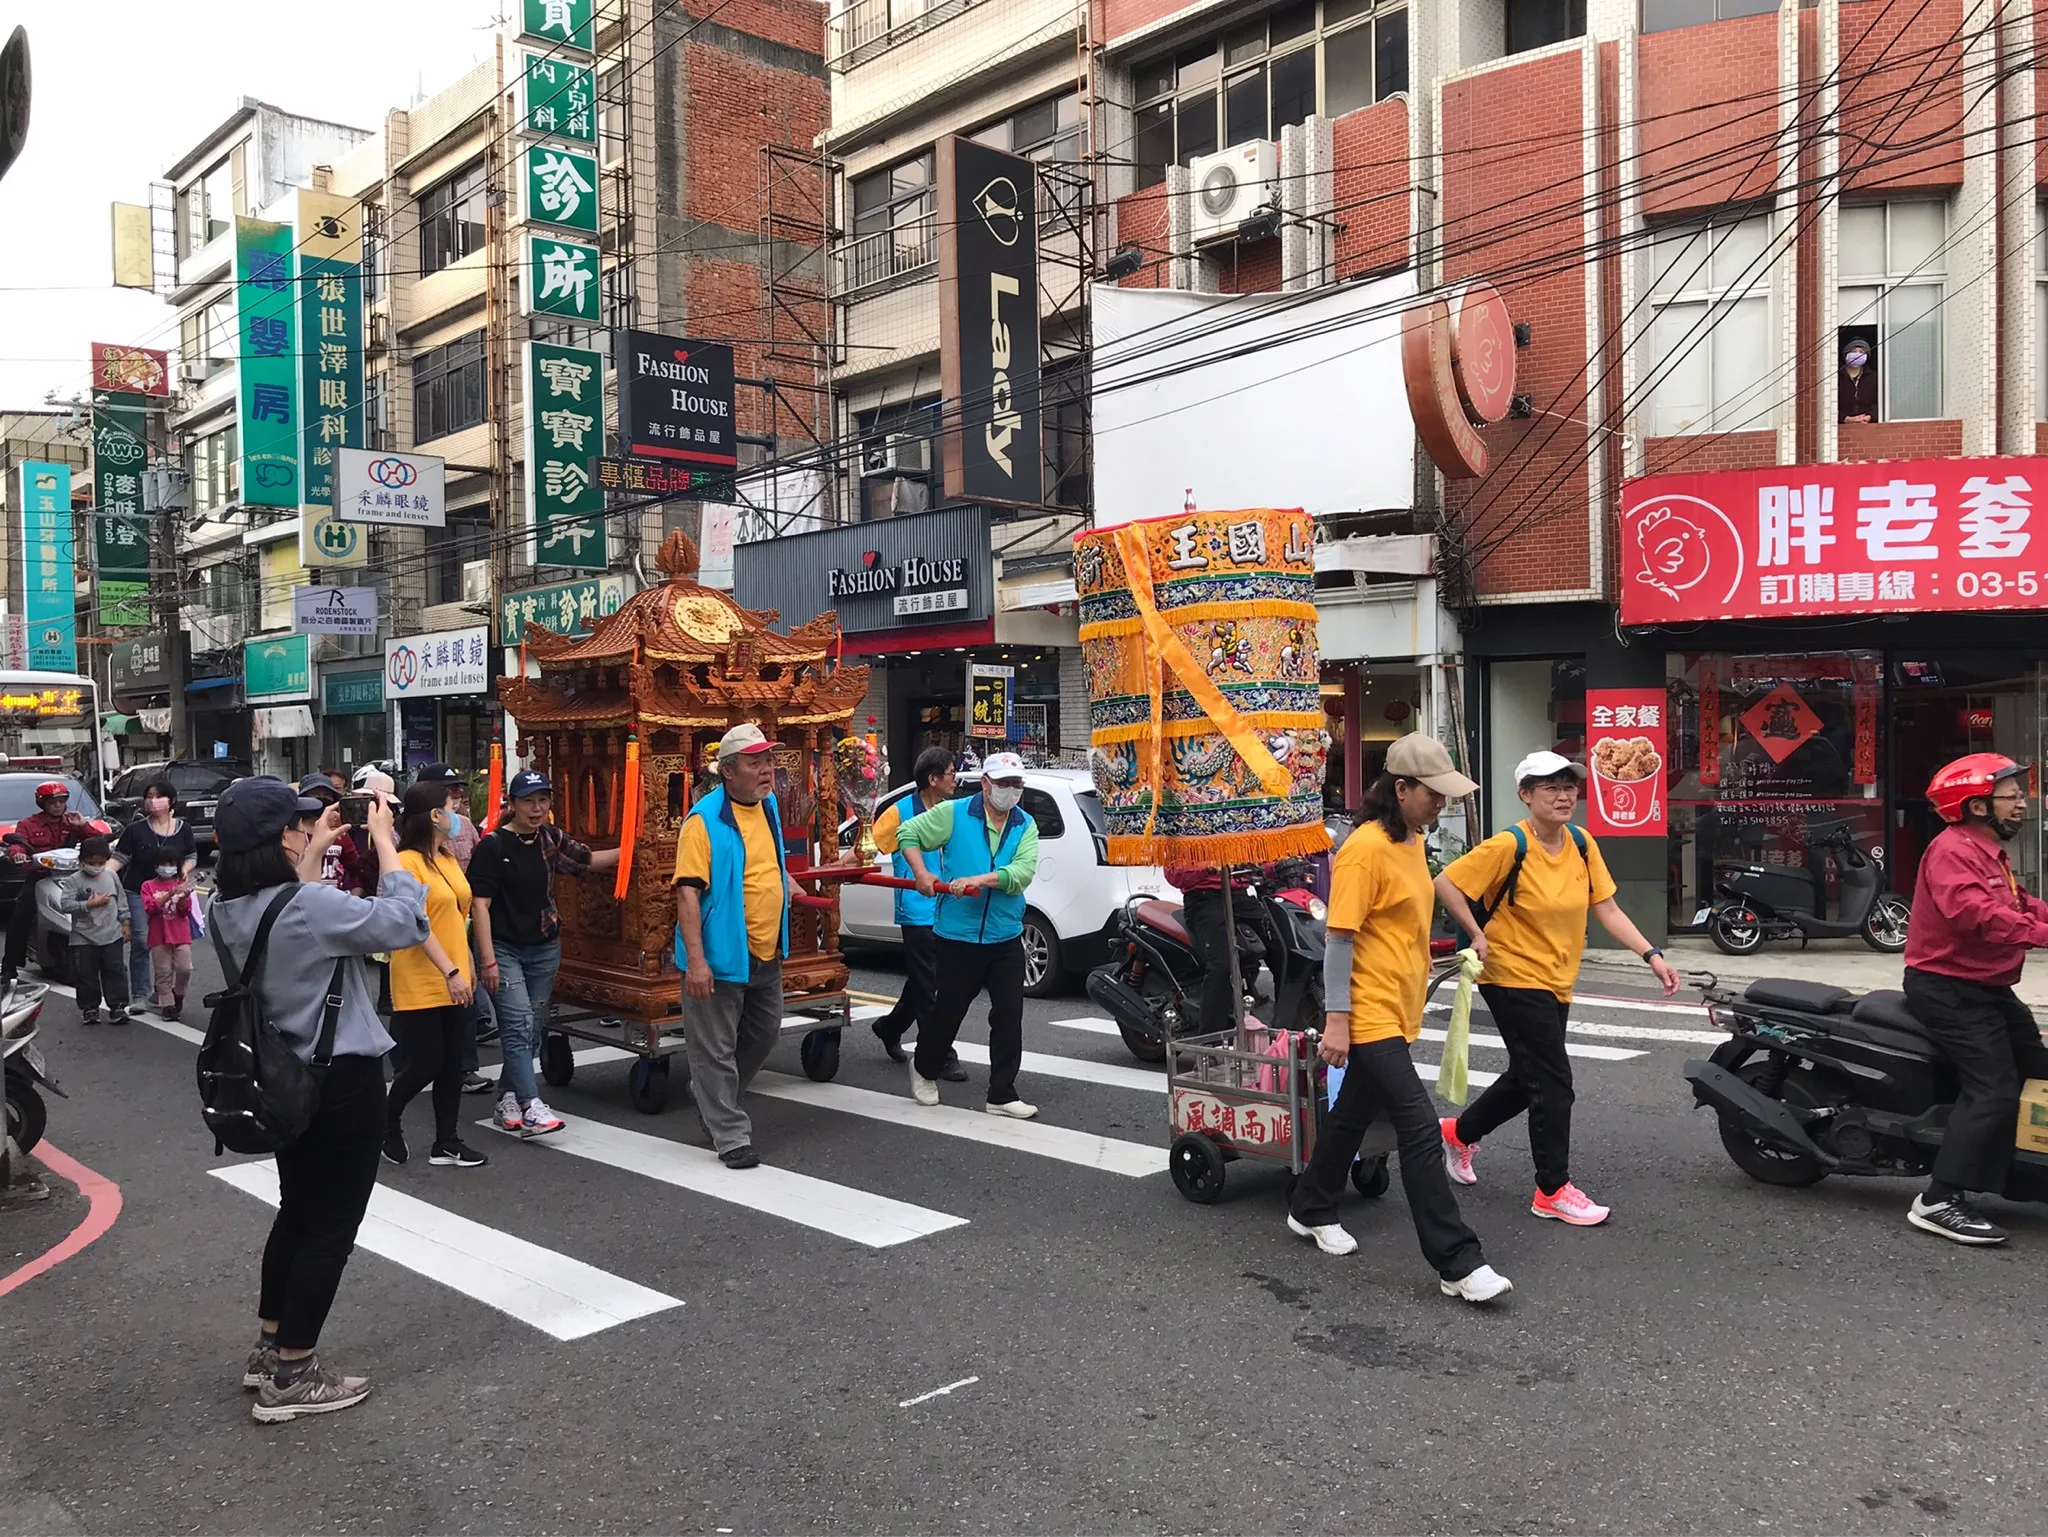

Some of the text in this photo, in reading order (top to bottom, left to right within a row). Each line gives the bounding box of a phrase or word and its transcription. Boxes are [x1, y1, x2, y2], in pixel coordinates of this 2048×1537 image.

[532, 59, 558, 131] 內科
[565, 66, 591, 138] 小兒科
[532, 151, 594, 314] 診所
[316, 270, 350, 445] 張世澤眼科
[637, 351, 710, 385] FASHION
[985, 271, 1023, 480] Lady
[670, 388, 729, 418] HOUSE
[648, 421, 722, 445] 流行飾品屋
[539, 357, 596, 557] 寶寶診所
[115, 473, 138, 546] 麥味登
[357, 489, 430, 512] 采麟眼鏡
[357, 507, 429, 521] frame and lenses
[104, 506, 116, 545] Bunch
[1757, 475, 2034, 567] 胖老爹
[827, 556, 963, 598] FASHION HOUSE
[1956, 571, 2048, 603] 03-5
[315, 606, 358, 616] RODENSTOCK
[897, 593, 958, 613] 流行飾品屋
[419, 634, 485, 673] 采麟眼鏡
[419, 671, 485, 689] frame and lenses
[973, 684, 992, 724] 一統
[1592, 704, 1660, 728] 全家餐
[1186, 1100, 1292, 1148] 風調雨順
